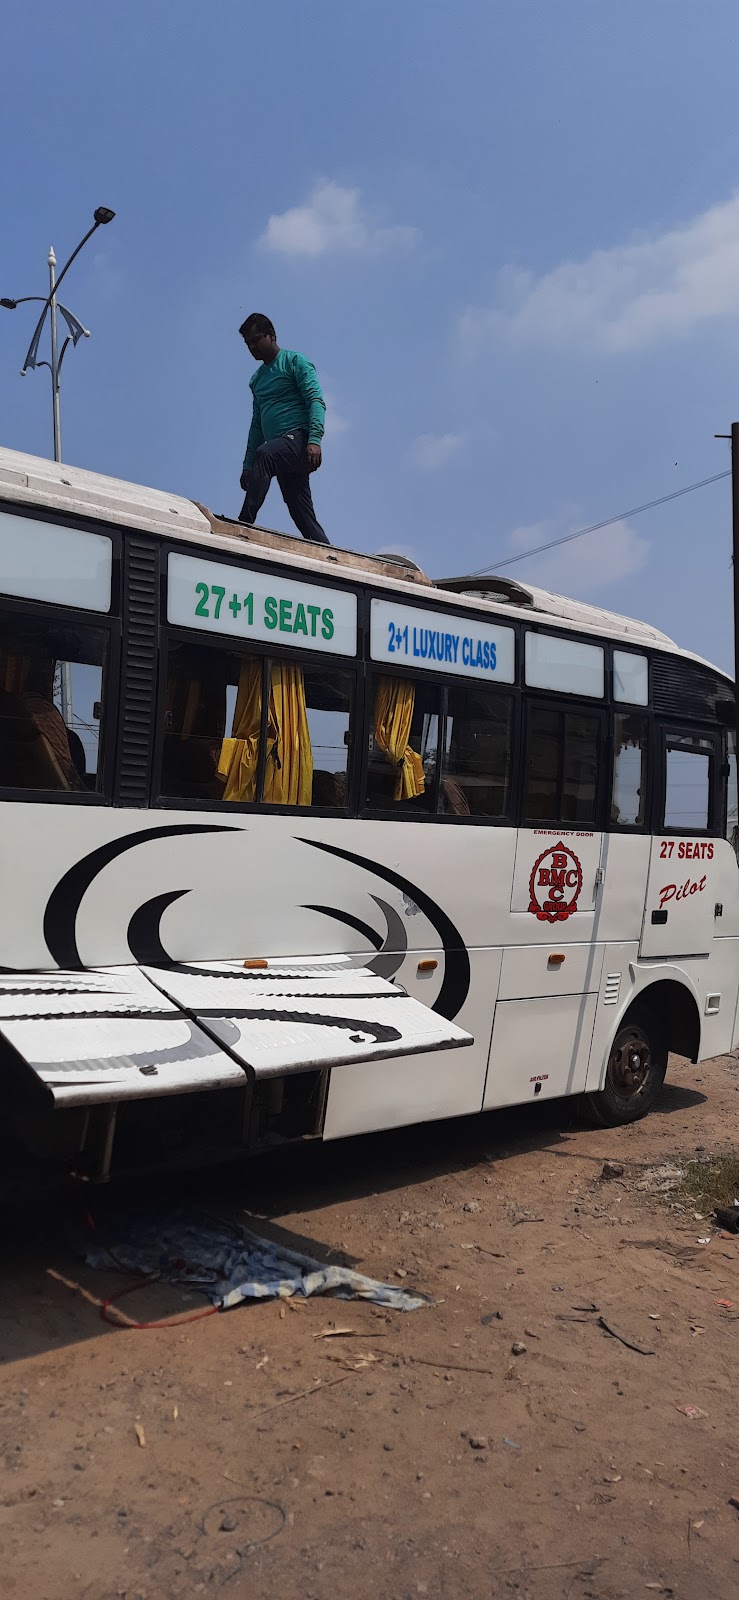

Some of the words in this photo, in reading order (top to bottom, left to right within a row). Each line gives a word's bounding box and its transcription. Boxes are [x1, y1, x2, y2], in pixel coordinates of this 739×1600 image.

[195, 582, 254, 625] 27+1
[263, 596, 335, 640] SEATS
[388, 621, 409, 654] 2+1
[413, 627, 460, 663] LUXURY
[462, 638, 497, 671] CLASS
[660, 841, 675, 859] 27
[677, 841, 714, 860] SEATS
[551, 853, 567, 868] B
[537, 869, 578, 887] BMC
[659, 874, 707, 909] Pilot
[543, 901, 567, 911] GROUP
